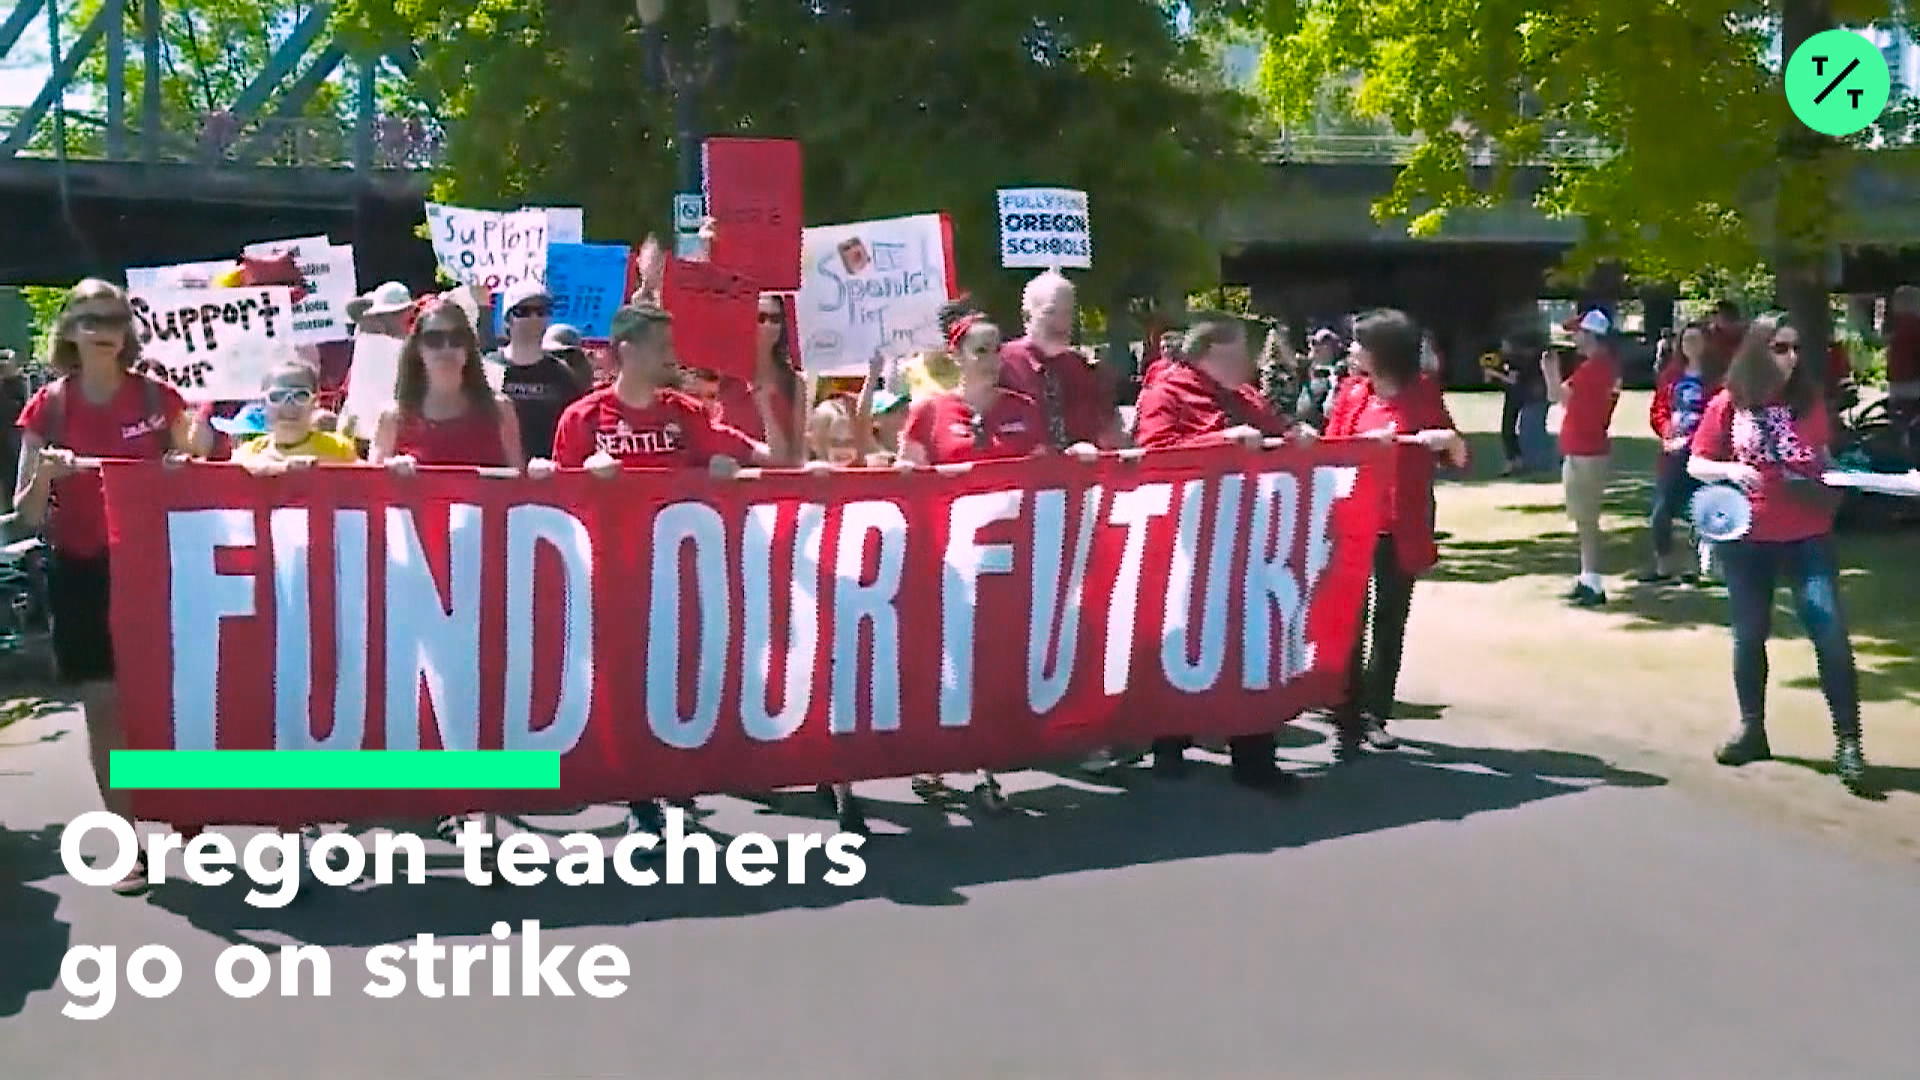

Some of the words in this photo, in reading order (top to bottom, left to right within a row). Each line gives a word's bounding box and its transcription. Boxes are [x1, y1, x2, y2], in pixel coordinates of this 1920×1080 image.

[1004, 213, 1086, 233] OREGON
[1006, 237, 1087, 256] SCHOOLS
[130, 292, 280, 352] Support
[595, 431, 676, 453] SEATTLE
[168, 502, 594, 756] FUND
[646, 500, 909, 748] OUR
[938, 466, 1358, 726] FUTURE
